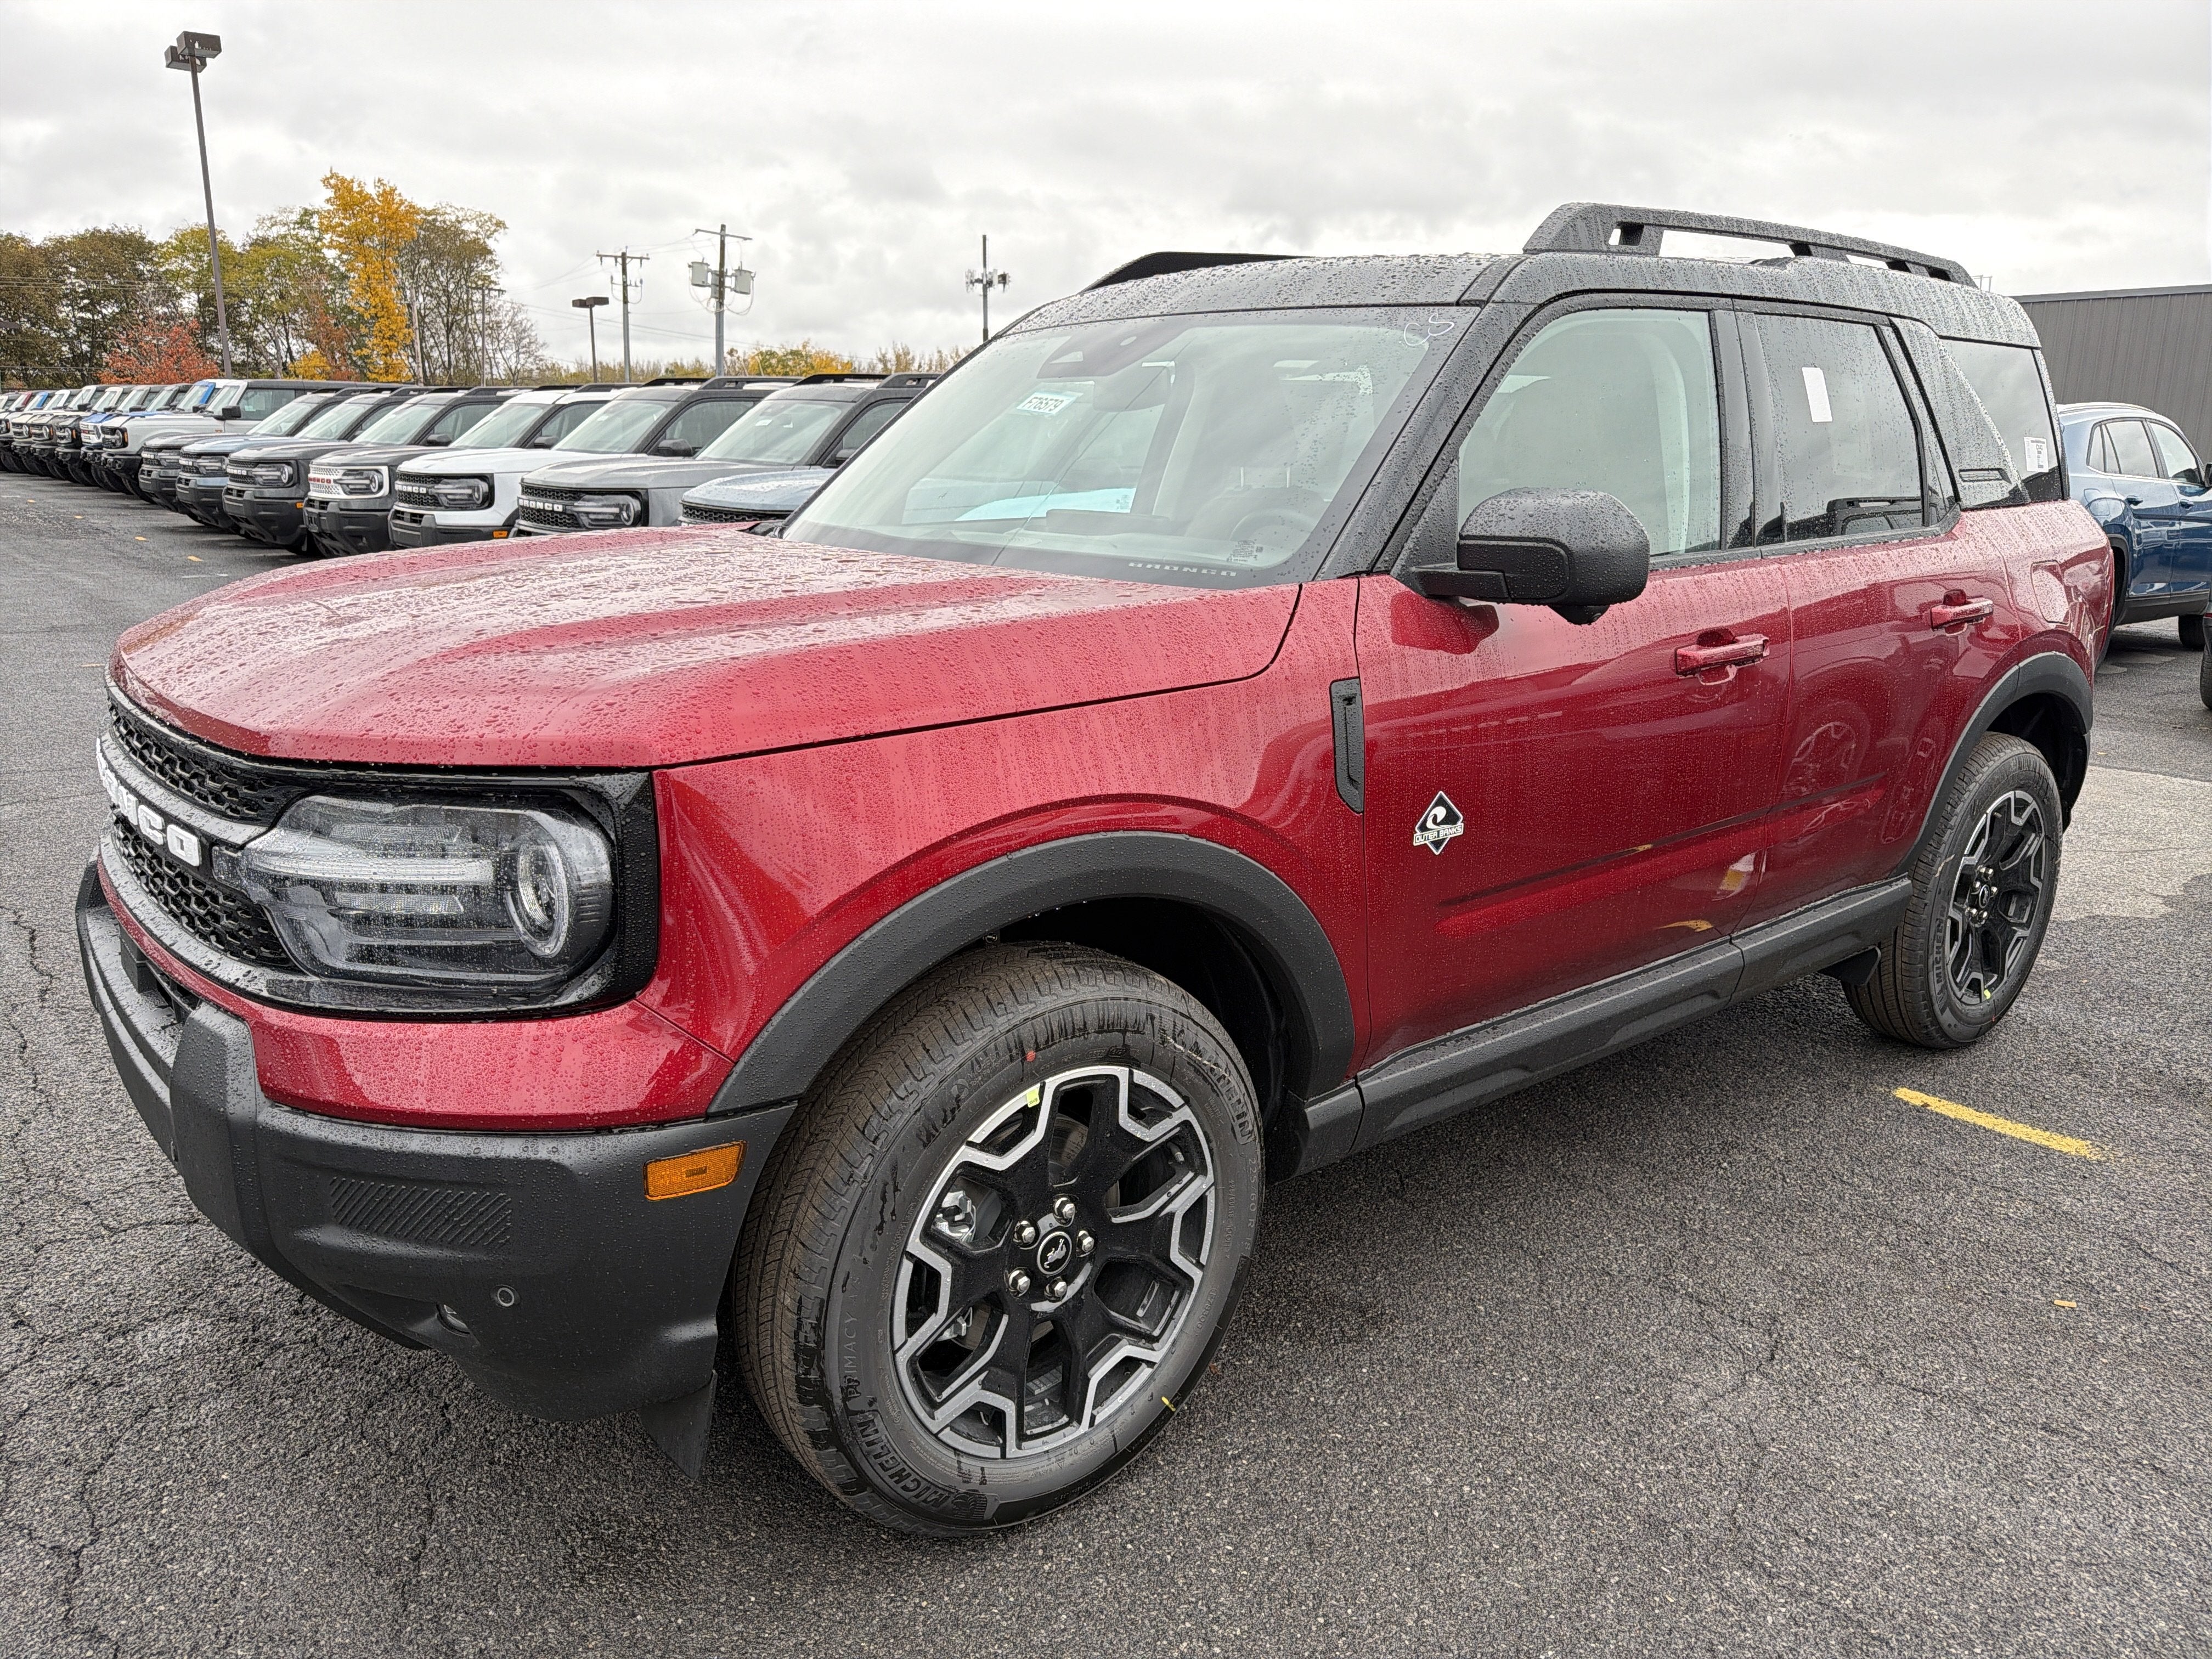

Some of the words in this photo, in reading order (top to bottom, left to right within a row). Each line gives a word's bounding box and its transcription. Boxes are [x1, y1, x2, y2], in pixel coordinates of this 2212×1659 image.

[518, 498, 563, 512] BRONCO
[1128, 562, 1237, 577] BRONCO
[1415, 832, 1438, 843] OUTER
[1439, 826, 1462, 837] BANKS
[843, 1311, 862, 1398] PRIMACY
[856, 1418, 951, 1508] MICHELIN
